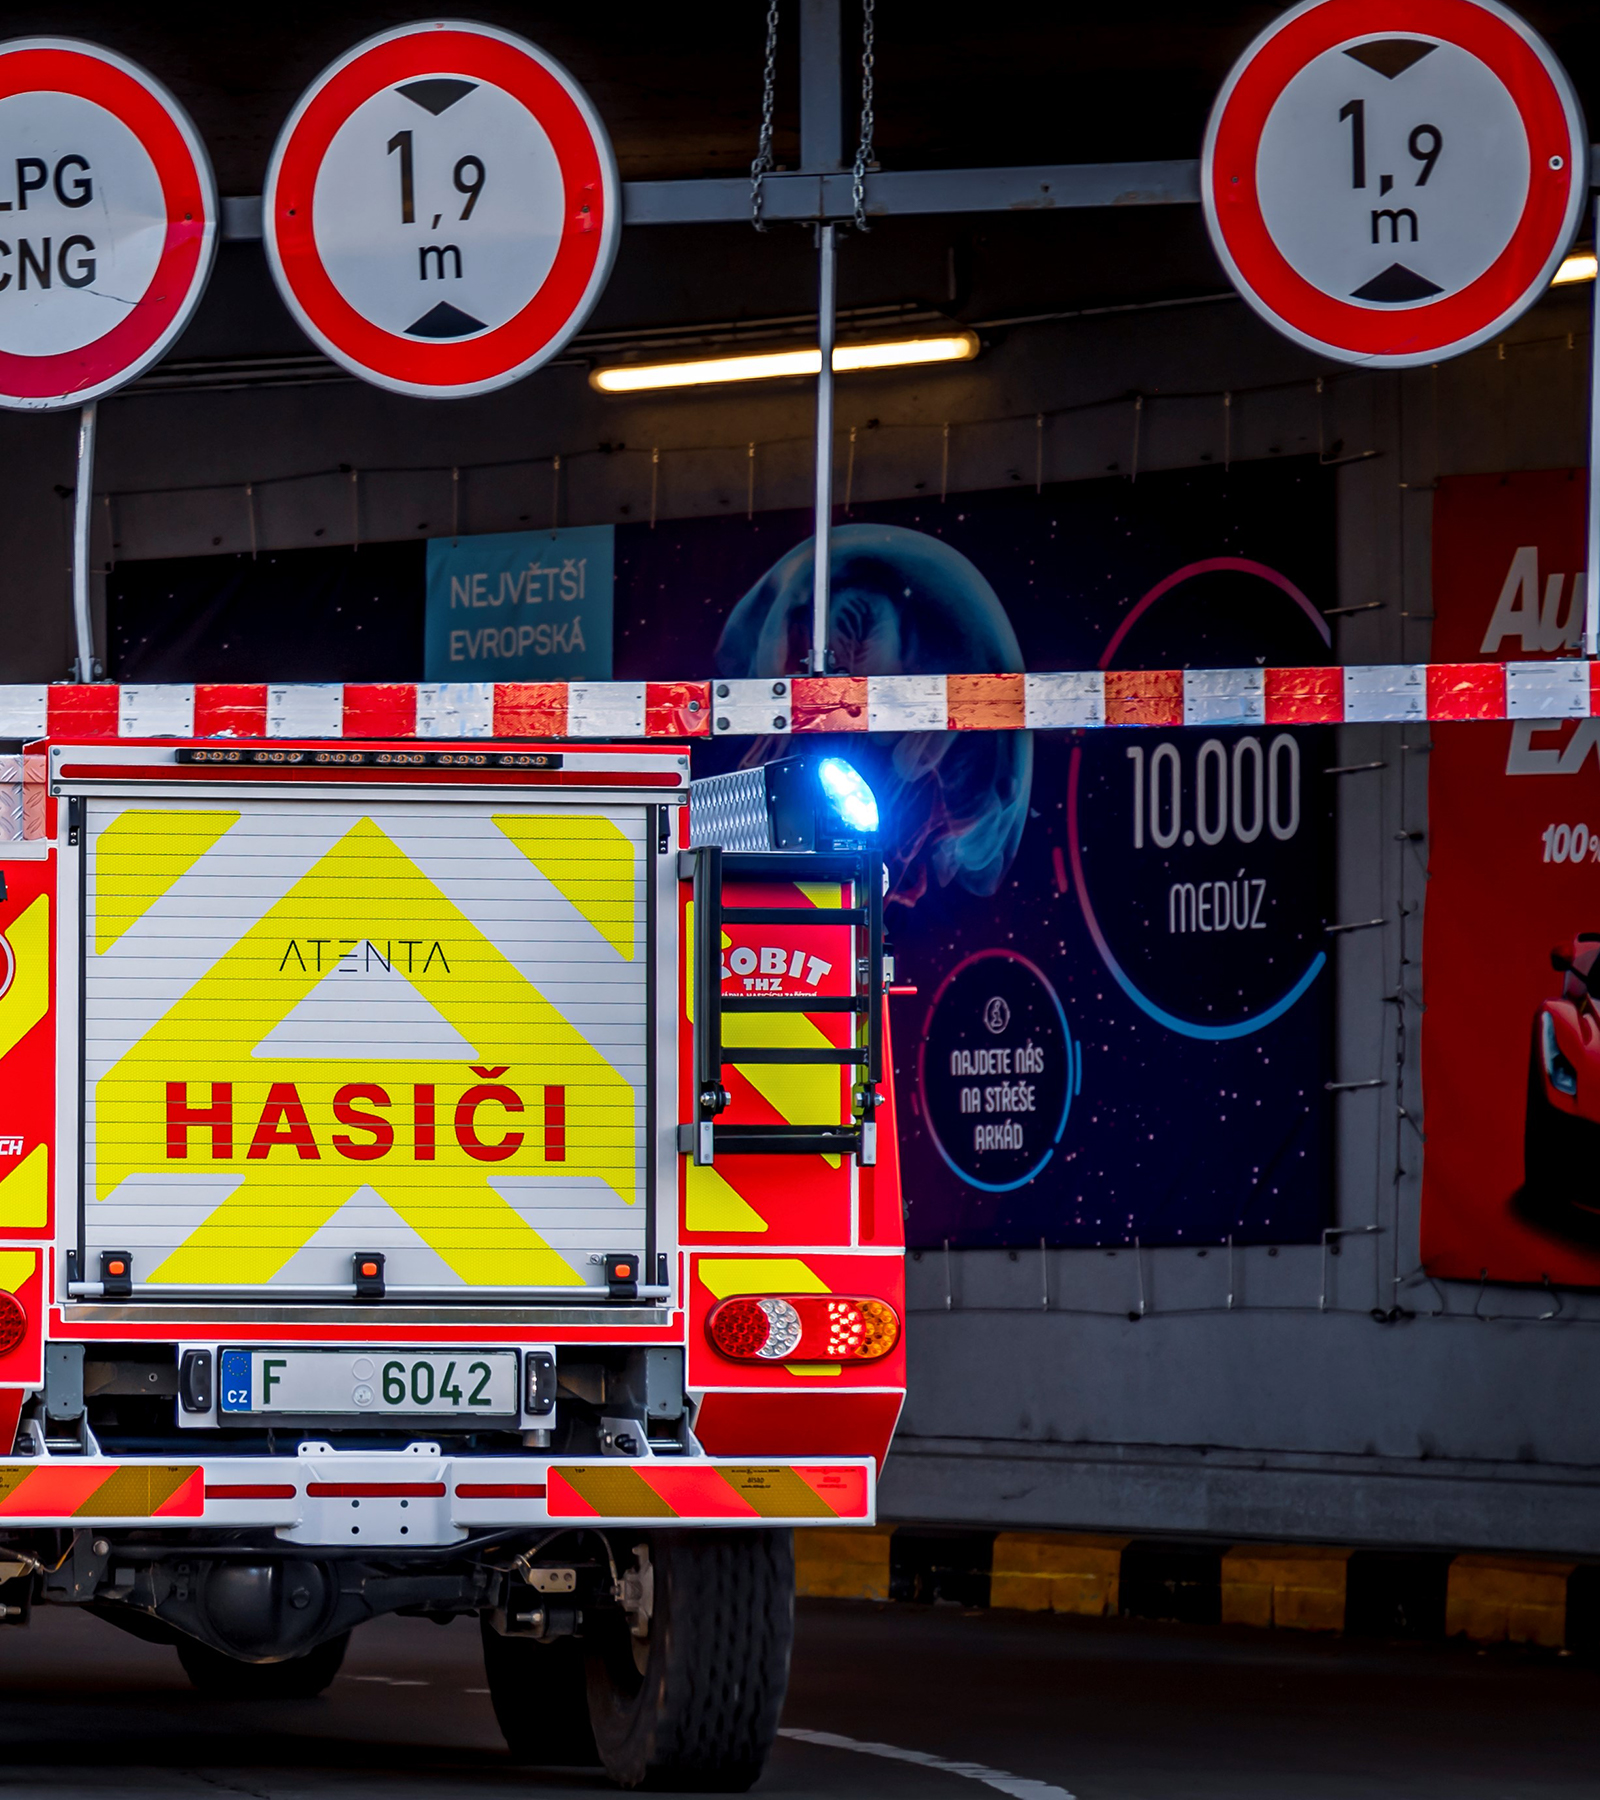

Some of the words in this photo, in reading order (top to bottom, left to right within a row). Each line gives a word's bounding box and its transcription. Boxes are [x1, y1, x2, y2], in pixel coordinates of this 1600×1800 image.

[1339, 98, 1443, 198] 1,9
[386, 129, 486, 230] 1,9
[1370, 206, 1419, 244] m
[418, 243, 463, 281] m
[450, 558, 588, 609] NEJVĚTŠÍ
[450, 615, 586, 662] EVROPSKÁ
[1125, 732, 1301, 849] 10.000
[1169, 867, 1267, 934] MEDÚZ
[278, 939, 451, 974] ATENTA
[742, 978, 783, 991] THZ
[951, 1048, 1012, 1076] NAJDETE
[1015, 1042, 1045, 1074] NÁS
[165, 1065, 567, 1163] HASIČI
[961, 1087, 982, 1114] NA
[984, 1080, 1037, 1113] STŘEŠE
[974, 1118, 1024, 1151] ARKÁD
[227, 1389, 249, 1404] CZ
[262, 1359, 288, 1406] F
[382, 1360, 493, 1407] 6042
